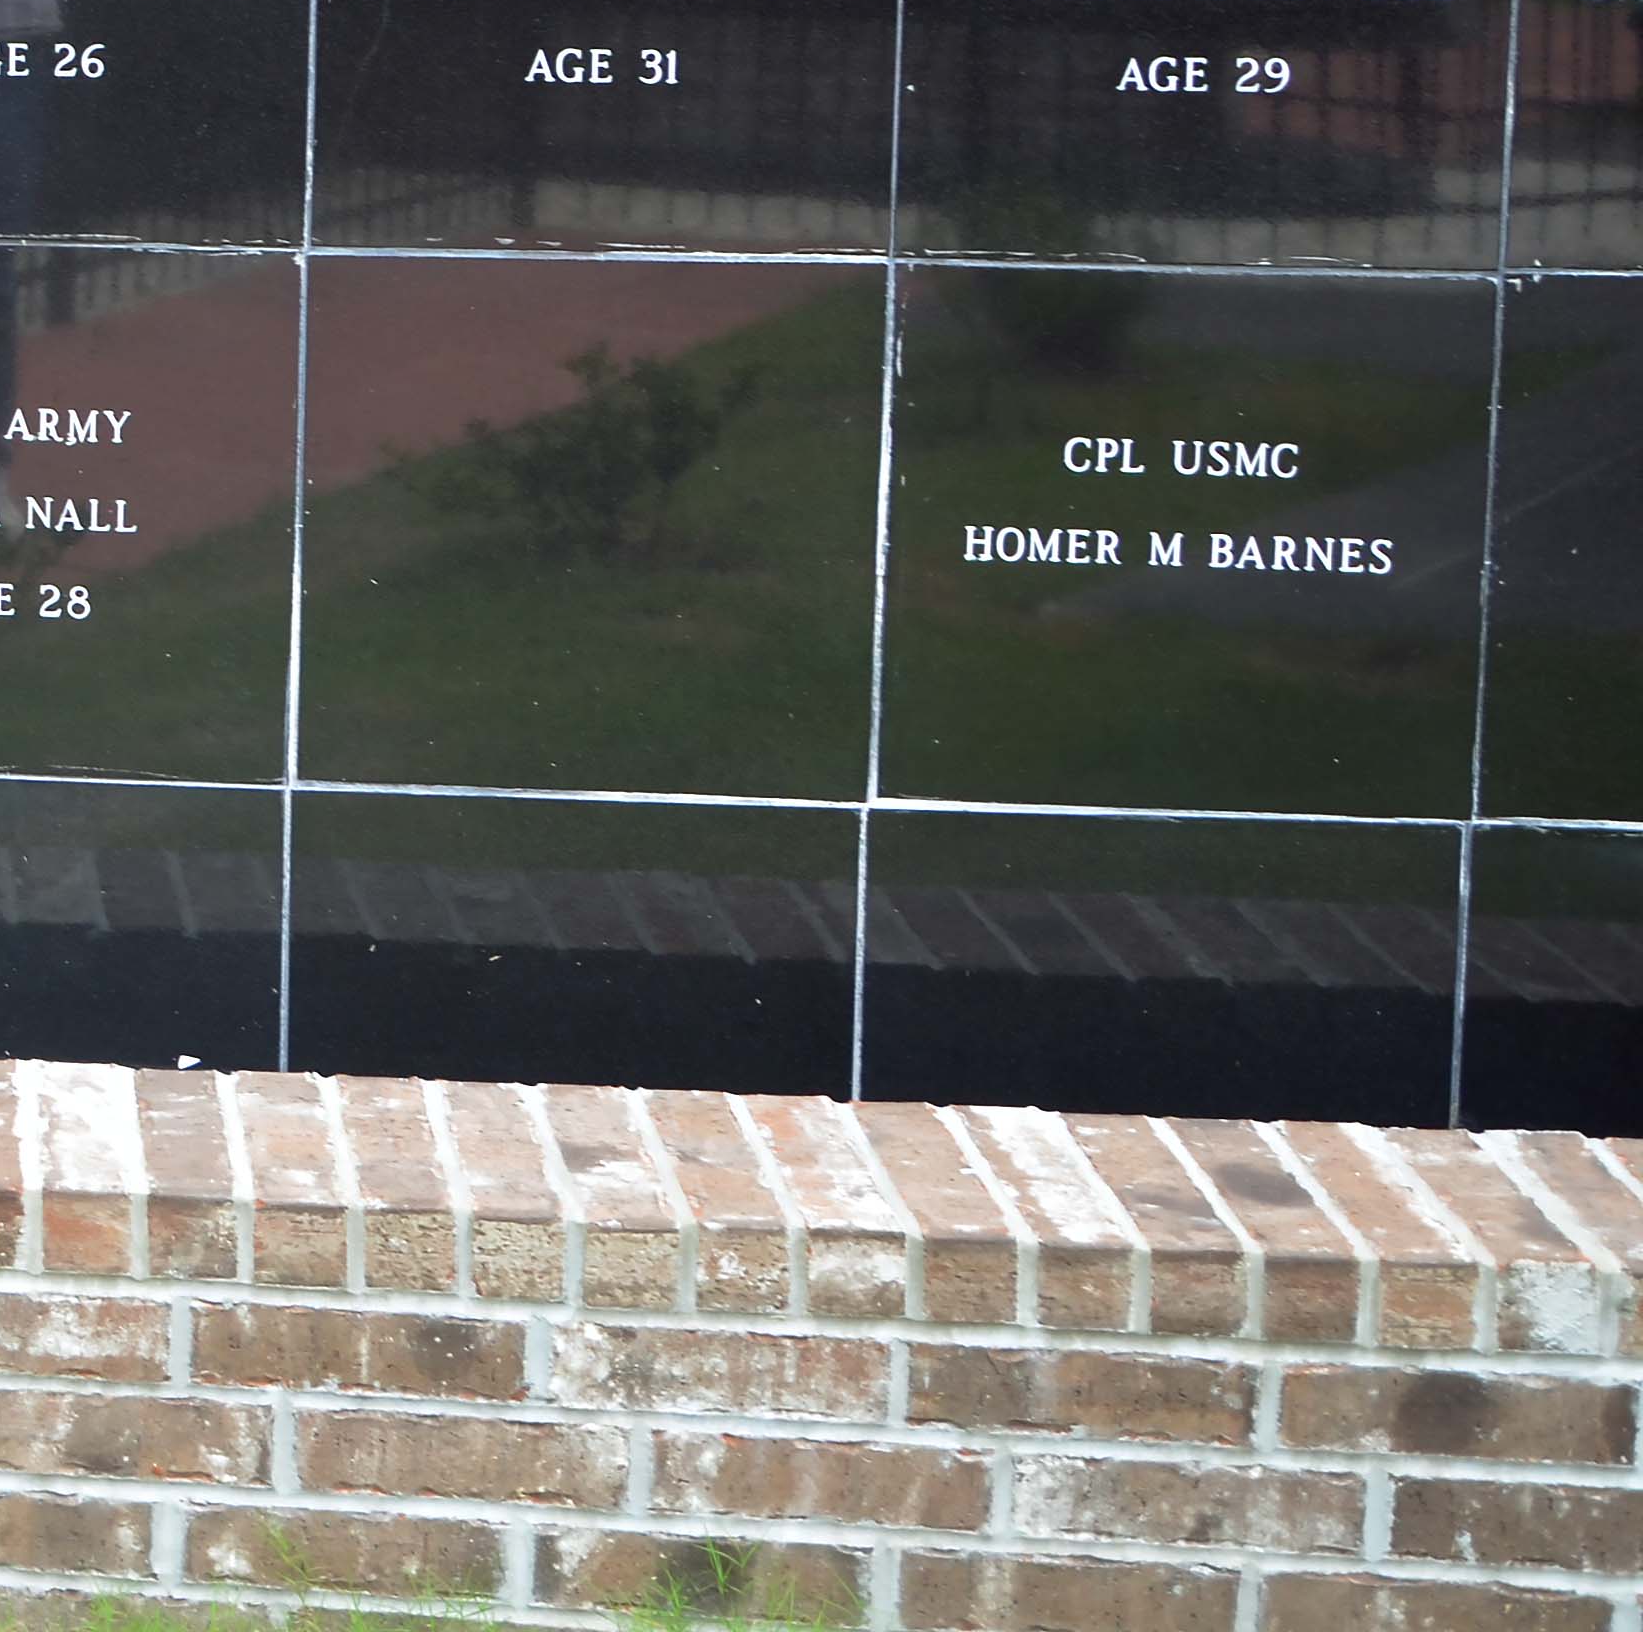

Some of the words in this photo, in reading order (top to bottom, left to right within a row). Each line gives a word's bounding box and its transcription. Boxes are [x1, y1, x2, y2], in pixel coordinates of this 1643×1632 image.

[53, 42, 106, 79] 26
[523, 46, 614, 85] AGE
[637, 48, 679, 86] 31
[1115, 55, 1209, 93] AGE
[1234, 56, 1291, 94] 29
[2, 406, 133, 447] ARMY
[1063, 435, 1146, 474] CPL
[1171, 439, 1299, 480] USMC
[24, 495, 139, 534] NALL
[962, 524, 1123, 566] HOMER
[1147, 530, 1185, 568] M
[1207, 532, 1394, 576] BARNES
[38, 583, 92, 621] 28
